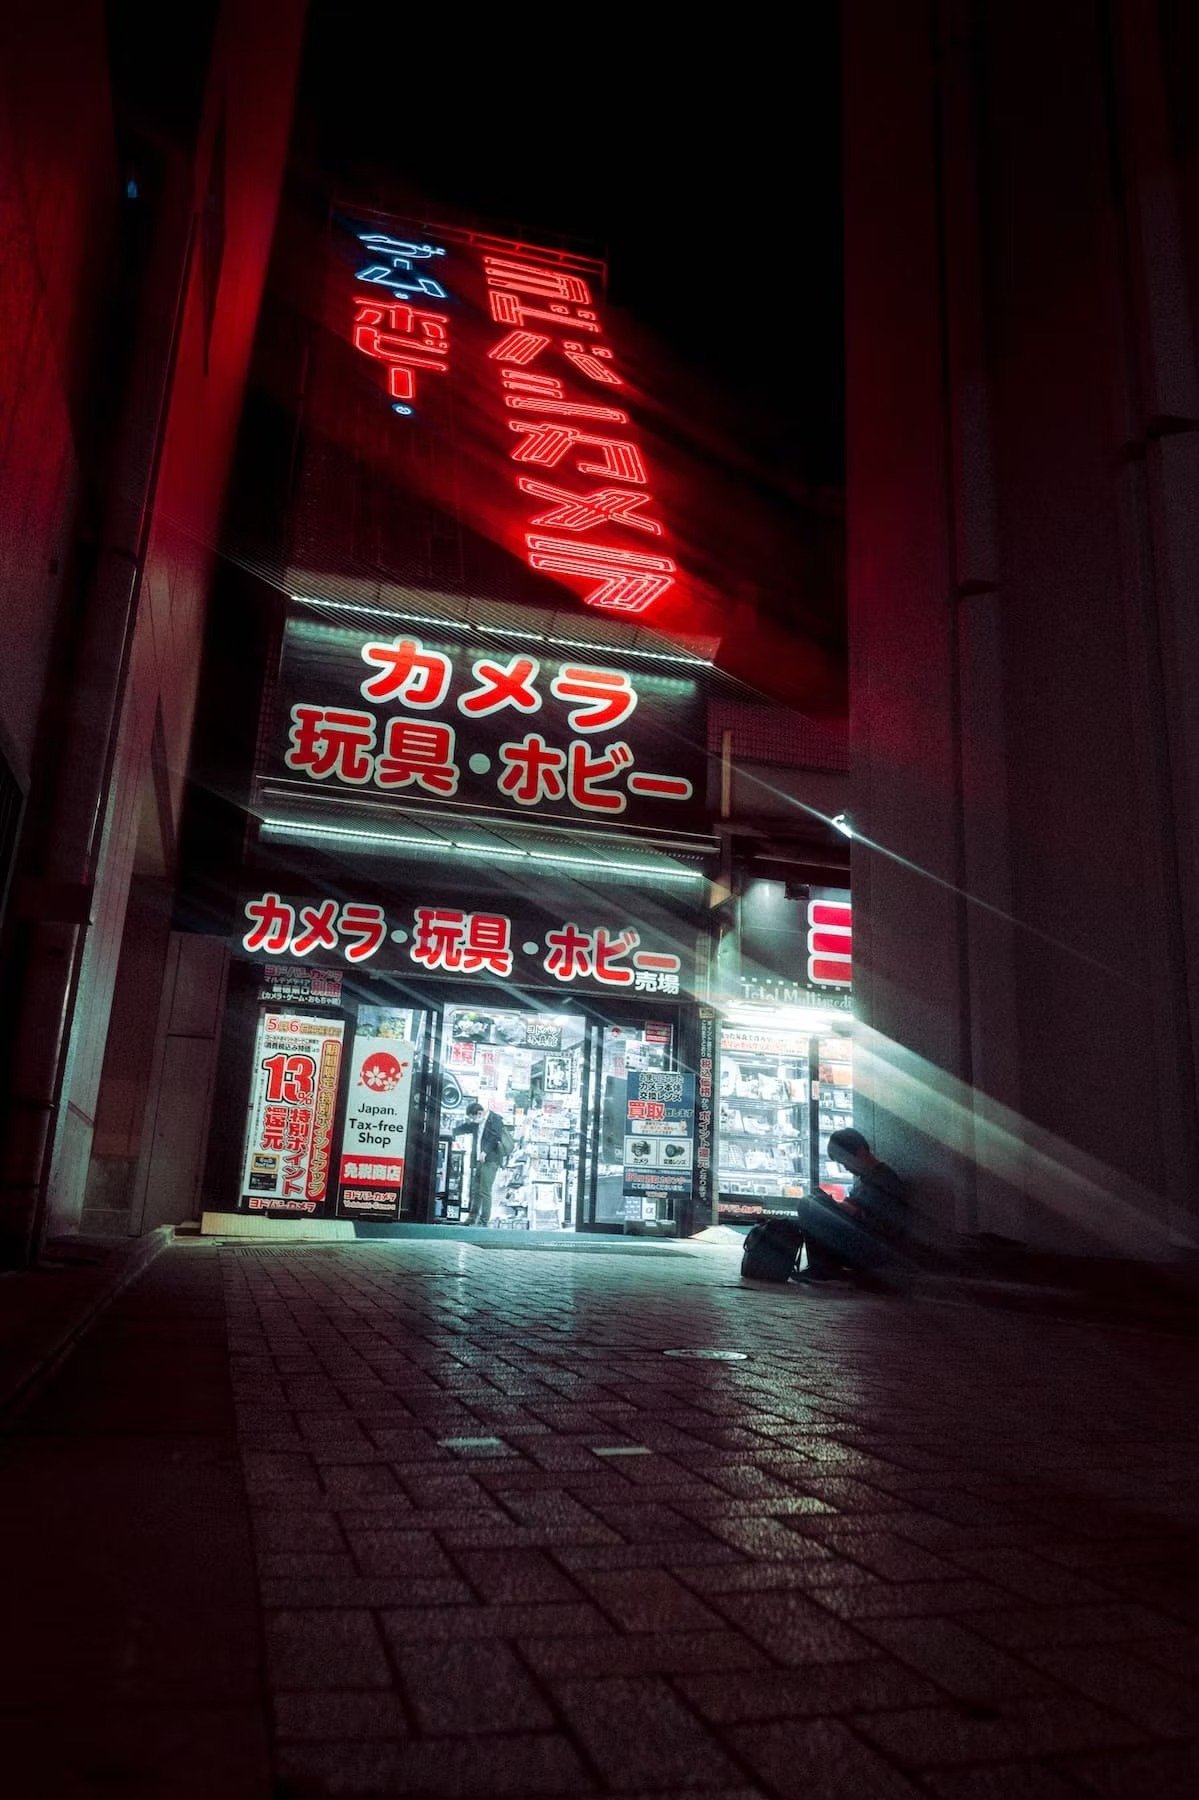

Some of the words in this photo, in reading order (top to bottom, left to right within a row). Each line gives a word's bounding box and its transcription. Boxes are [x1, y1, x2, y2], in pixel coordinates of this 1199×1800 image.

[484, 256, 676, 613] ヨドバシカメラ
[361, 636, 637, 734] カメラ
[285, 703, 693, 814] 玩具・ホビー
[243, 892, 681, 986] カメラ・玩具・ホビー
[634, 971, 680, 995] 売場
[349, 1118, 404, 1133] Tax-free
[358, 1103, 397, 1116] Japan.
[627, 1100, 665, 1121] 買取
[358, 1132, 391, 1148] Shop
